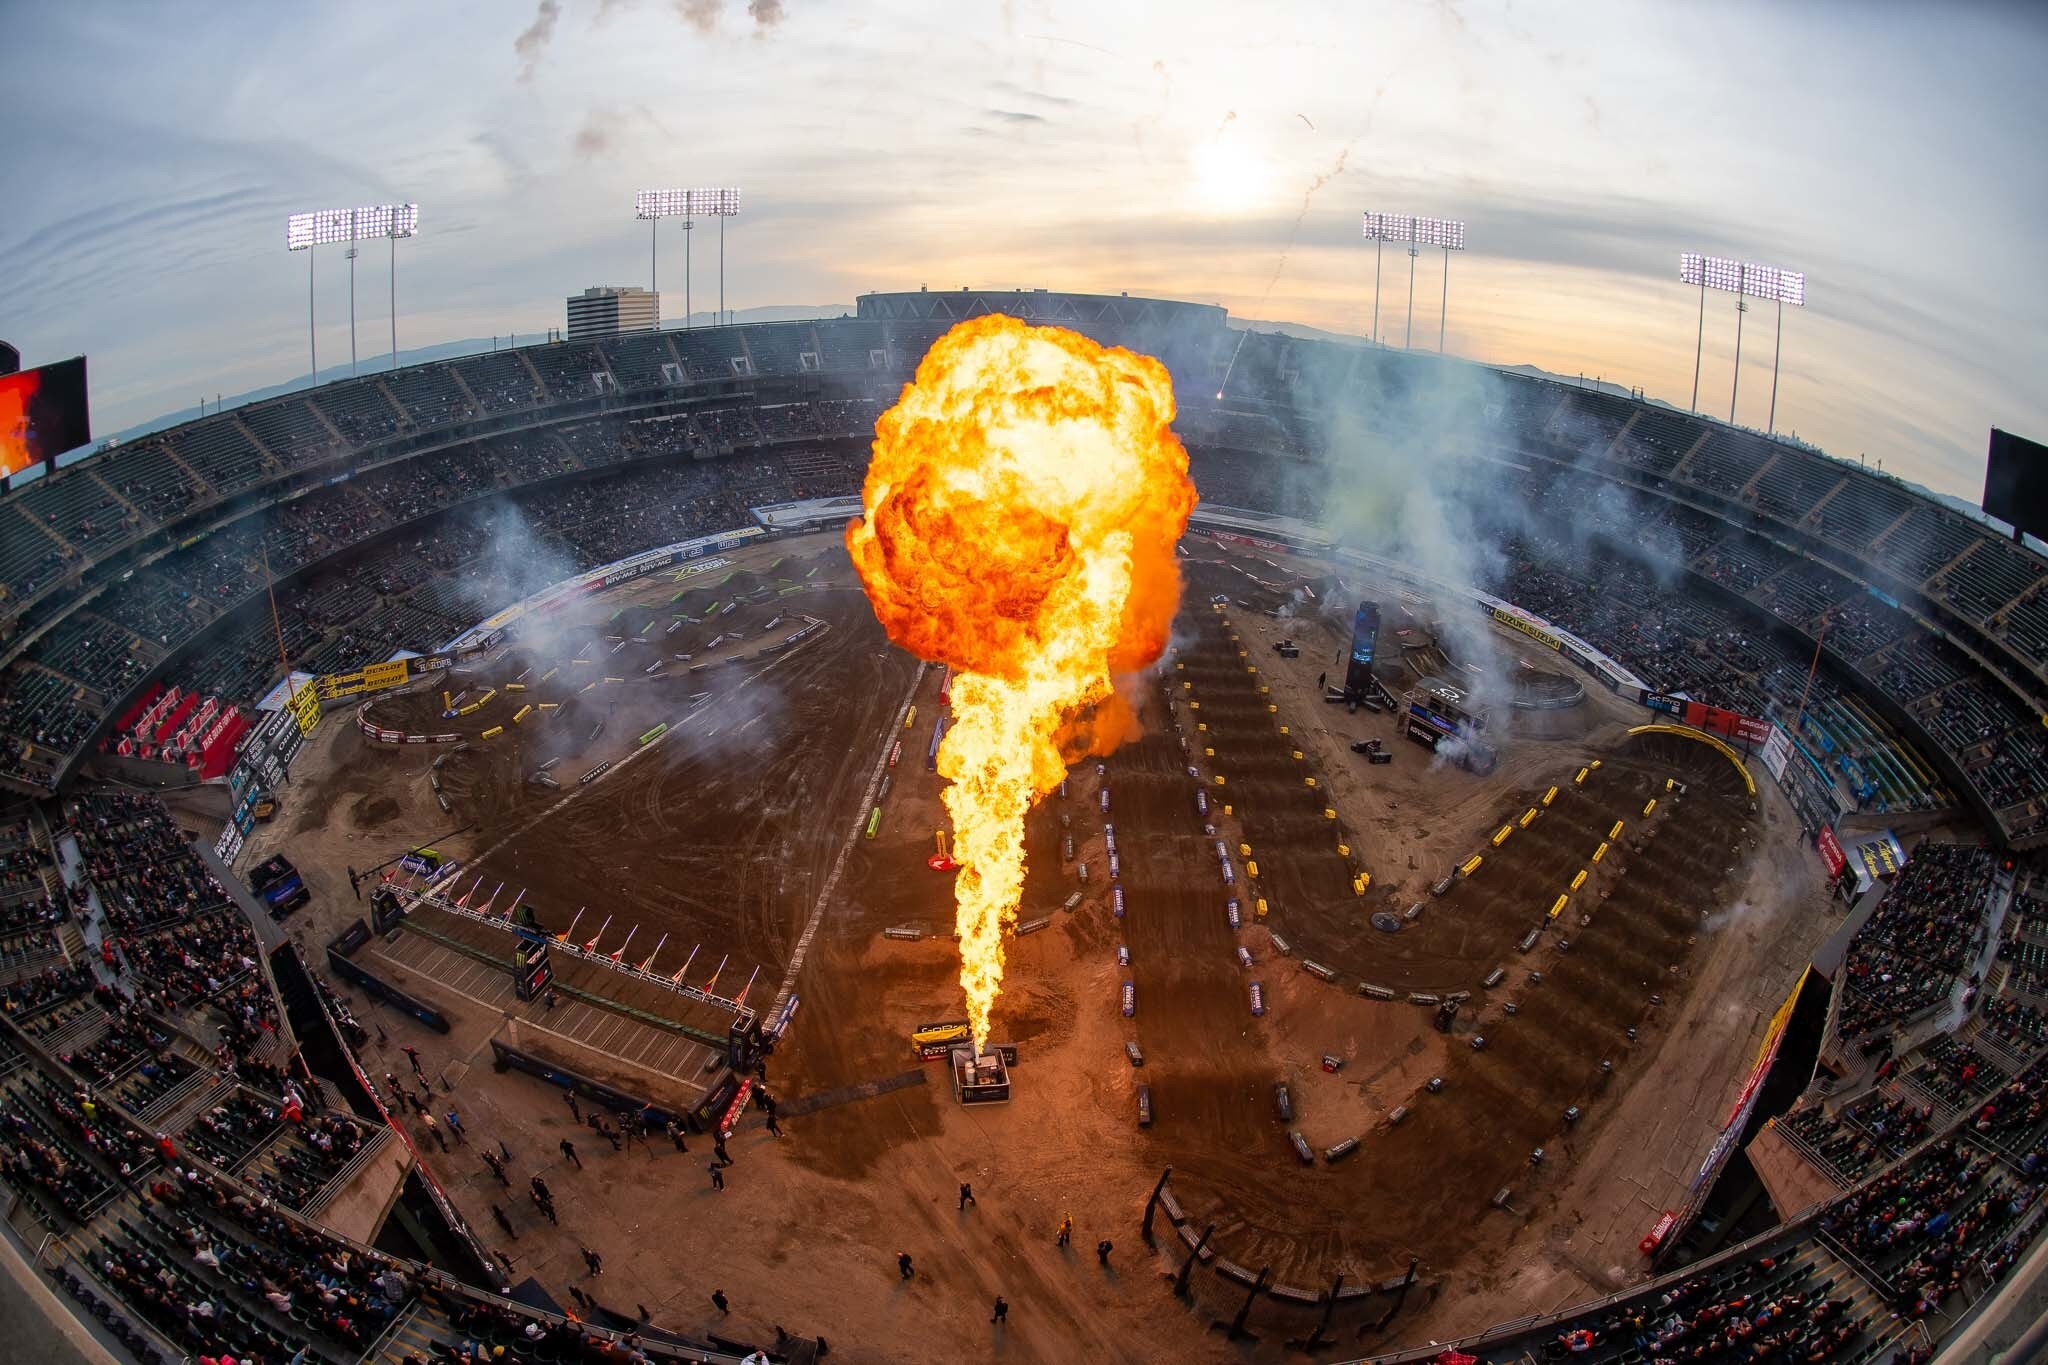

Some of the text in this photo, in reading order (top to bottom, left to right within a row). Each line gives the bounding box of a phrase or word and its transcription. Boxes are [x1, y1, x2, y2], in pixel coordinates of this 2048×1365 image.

[1495, 610, 1527, 631] SUZUKI
[1528, 626, 1560, 650] SUZUKI
[366, 663, 404, 675] DUNLOP
[367, 674, 405, 687] DUNLOP
[1739, 719, 1770, 732] GASGAS
